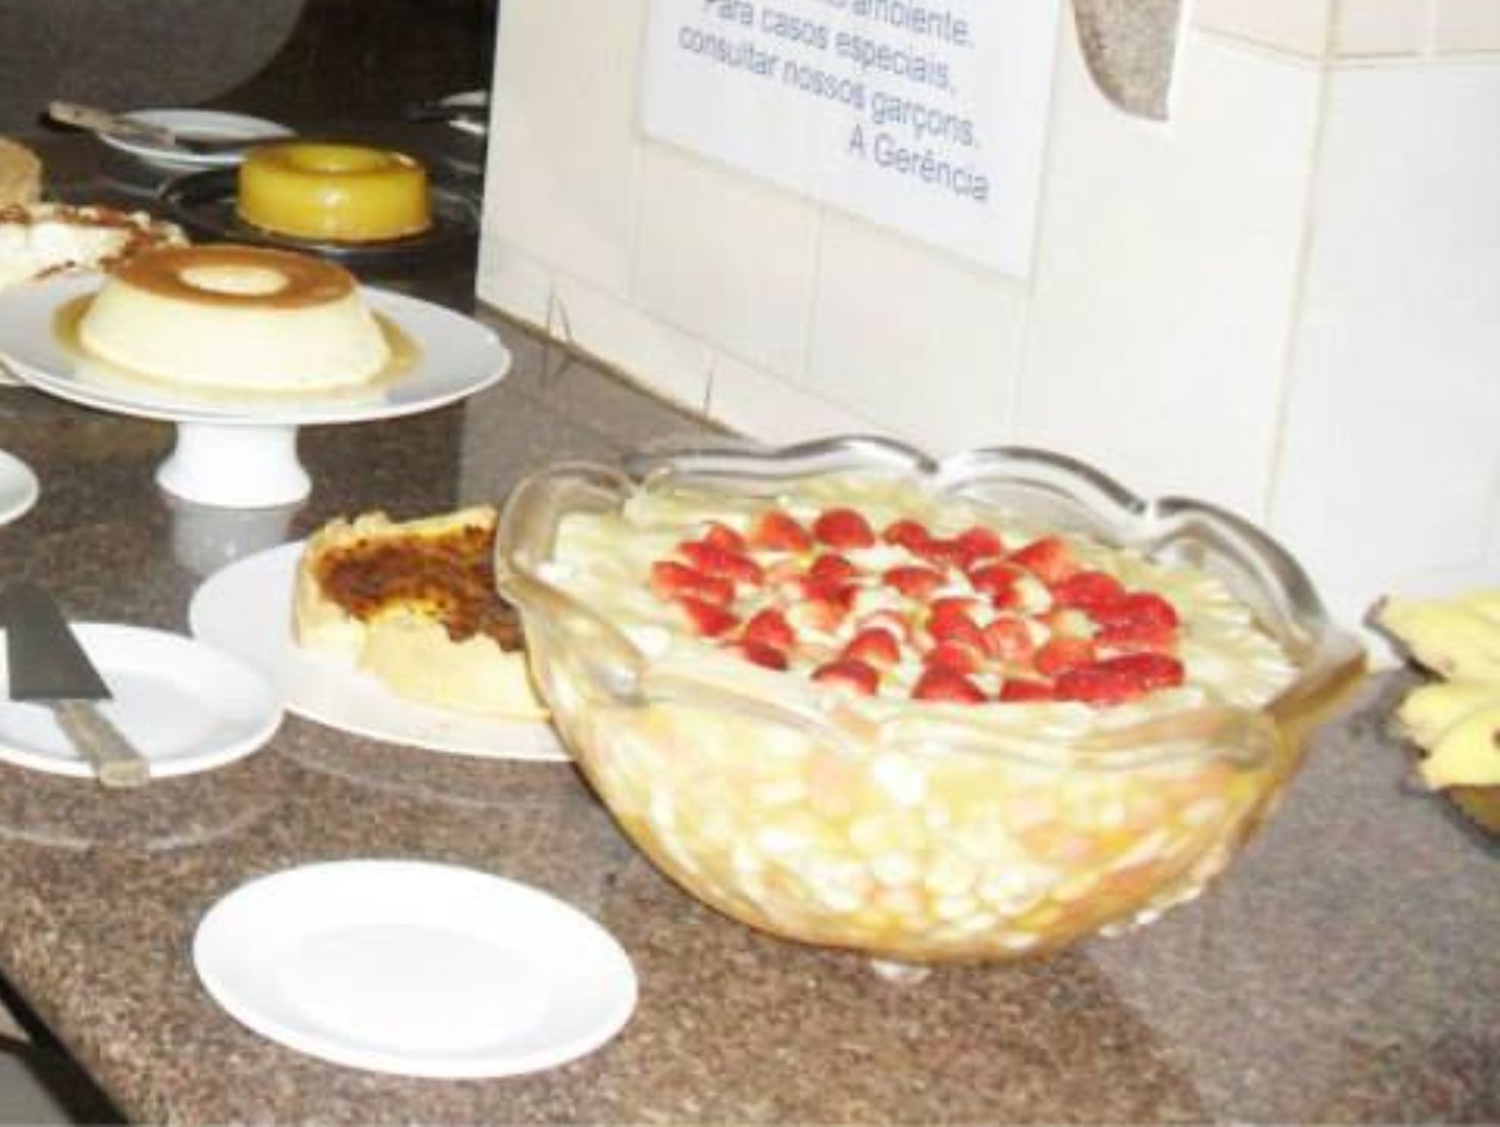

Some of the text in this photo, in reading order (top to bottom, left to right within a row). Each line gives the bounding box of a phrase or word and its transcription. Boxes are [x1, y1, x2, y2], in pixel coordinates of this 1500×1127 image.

[677, 24, 779, 76] consultar
[783, 58, 865, 110] nossos
[762, 7, 829, 50] casos
[848, 123, 990, 201] A Gerência
